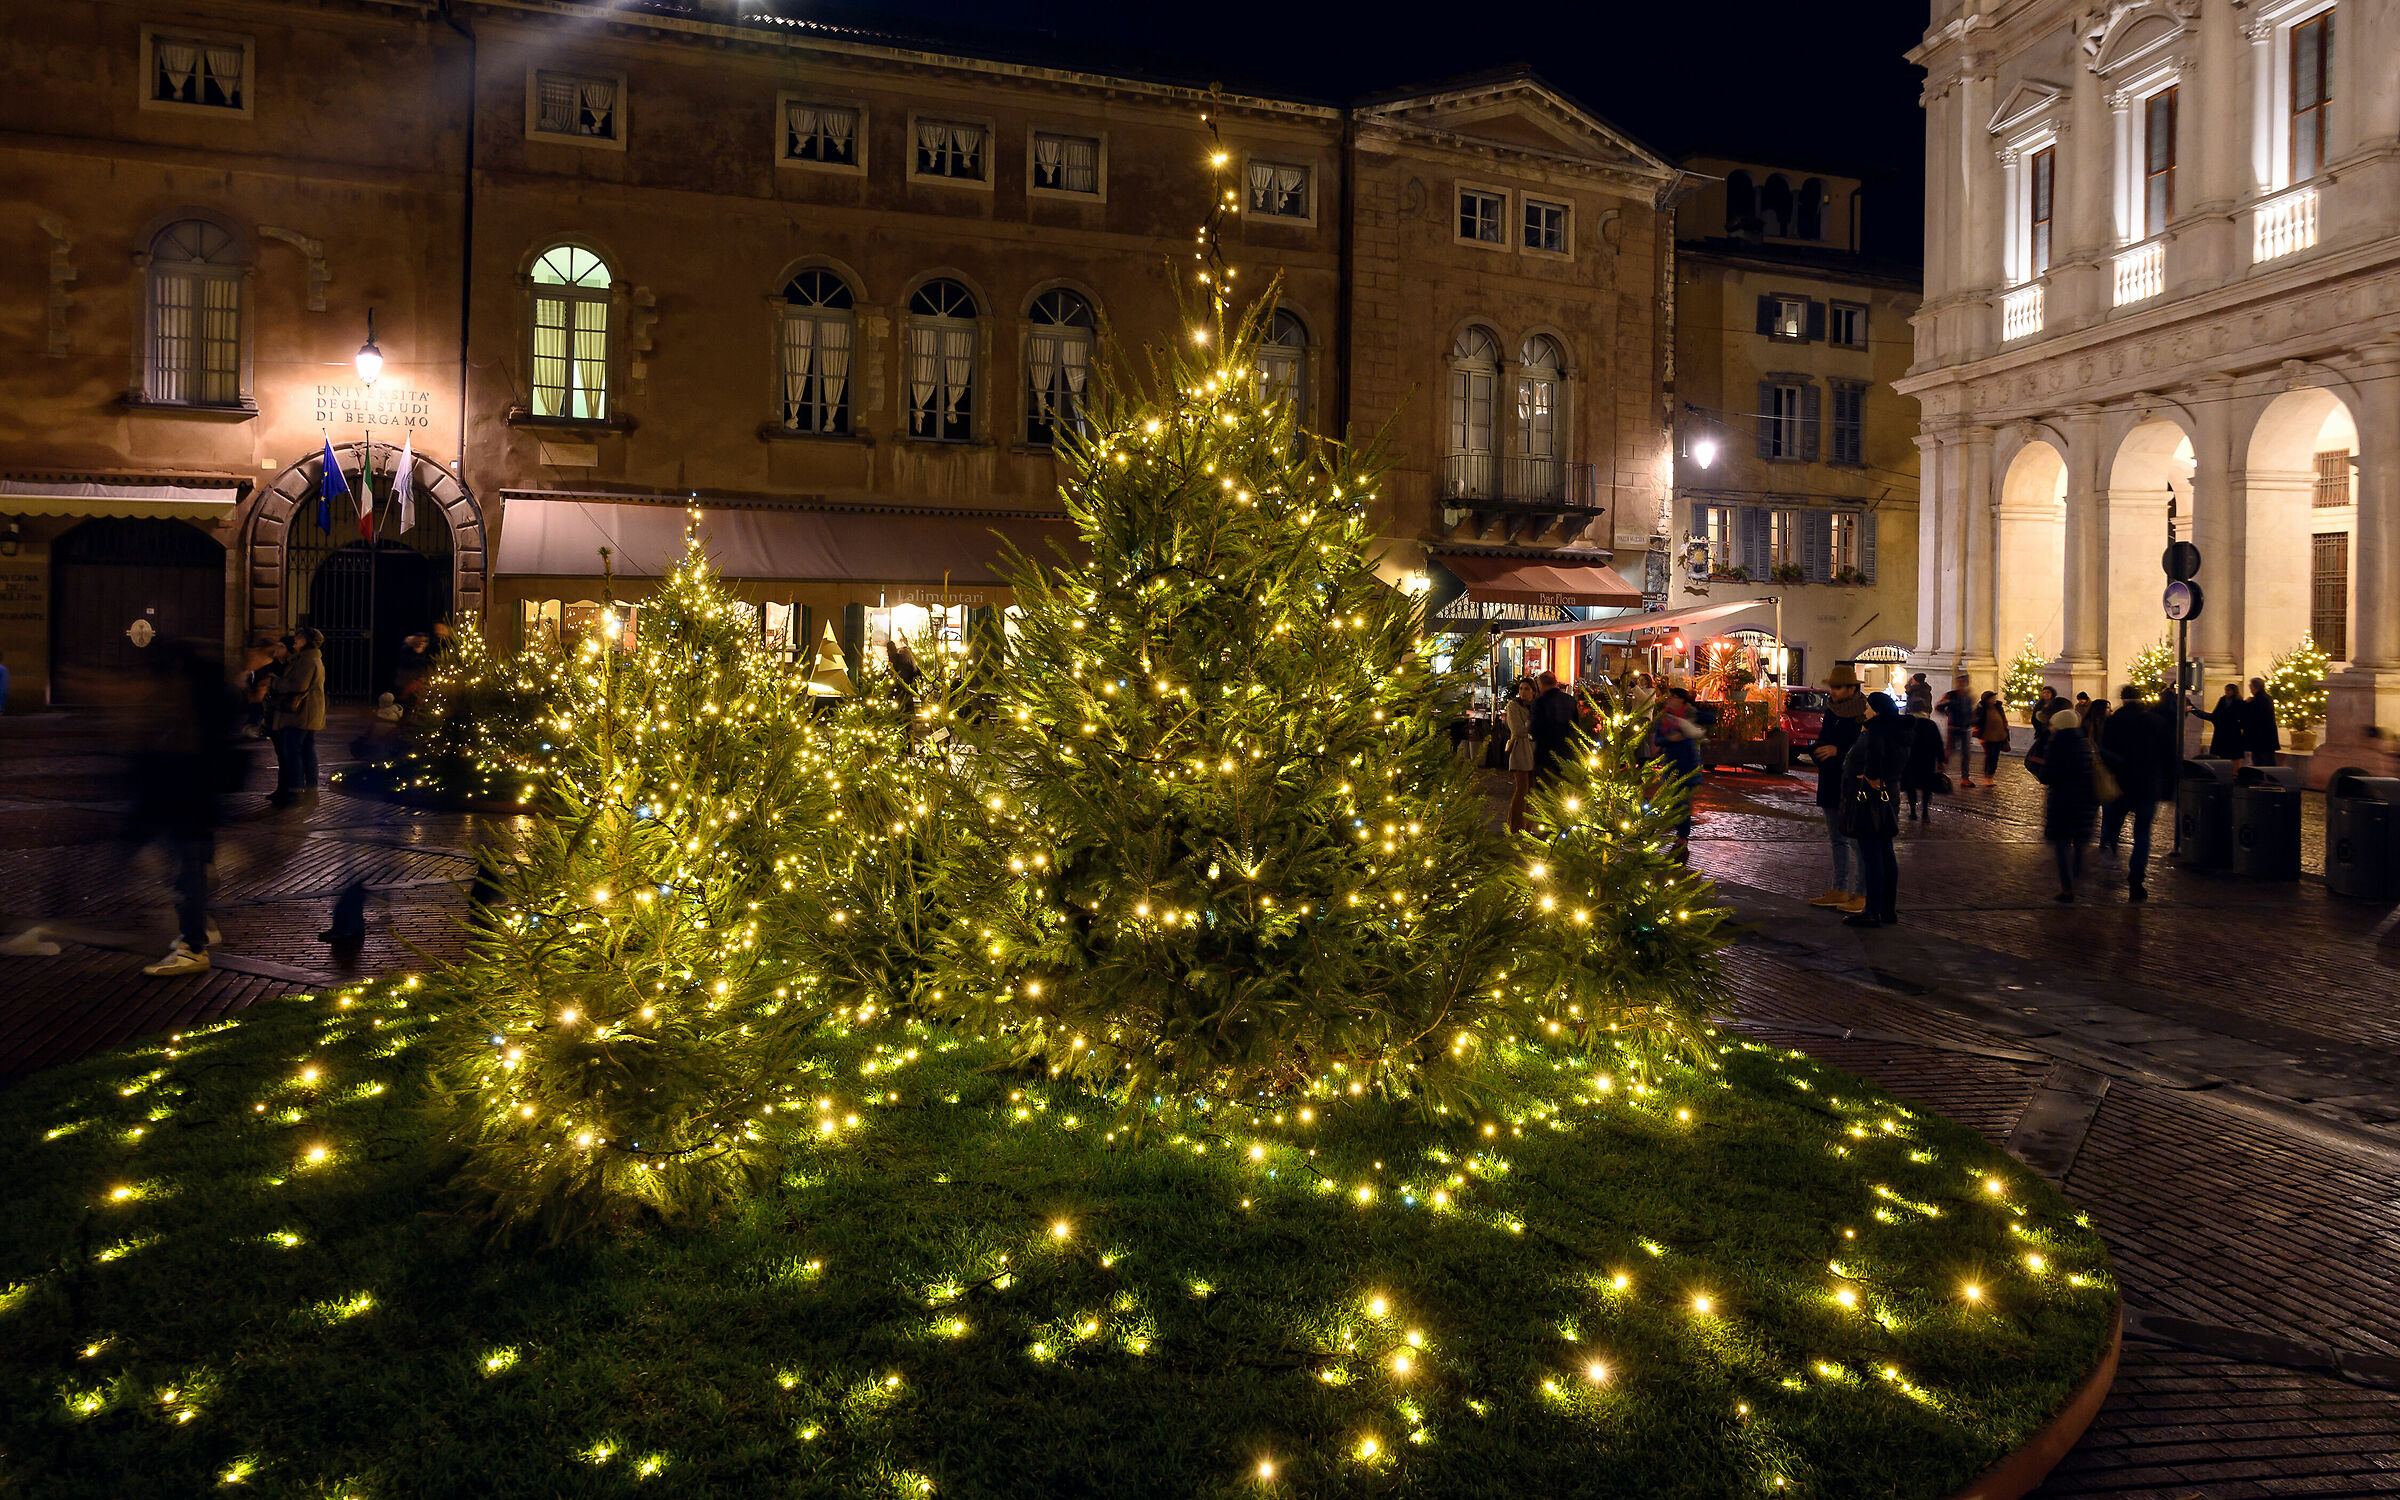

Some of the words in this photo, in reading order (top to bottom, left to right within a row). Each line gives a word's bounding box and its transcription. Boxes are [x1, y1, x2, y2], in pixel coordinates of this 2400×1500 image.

[317, 398, 369, 411] DEGLI
[378, 401, 429, 414] STUDI
[316, 411, 334, 421] DI
[345, 412, 429, 427] BERGAMO
[1540, 593, 1554, 604] Bar
[1555, 593, 1576, 605] Flora
